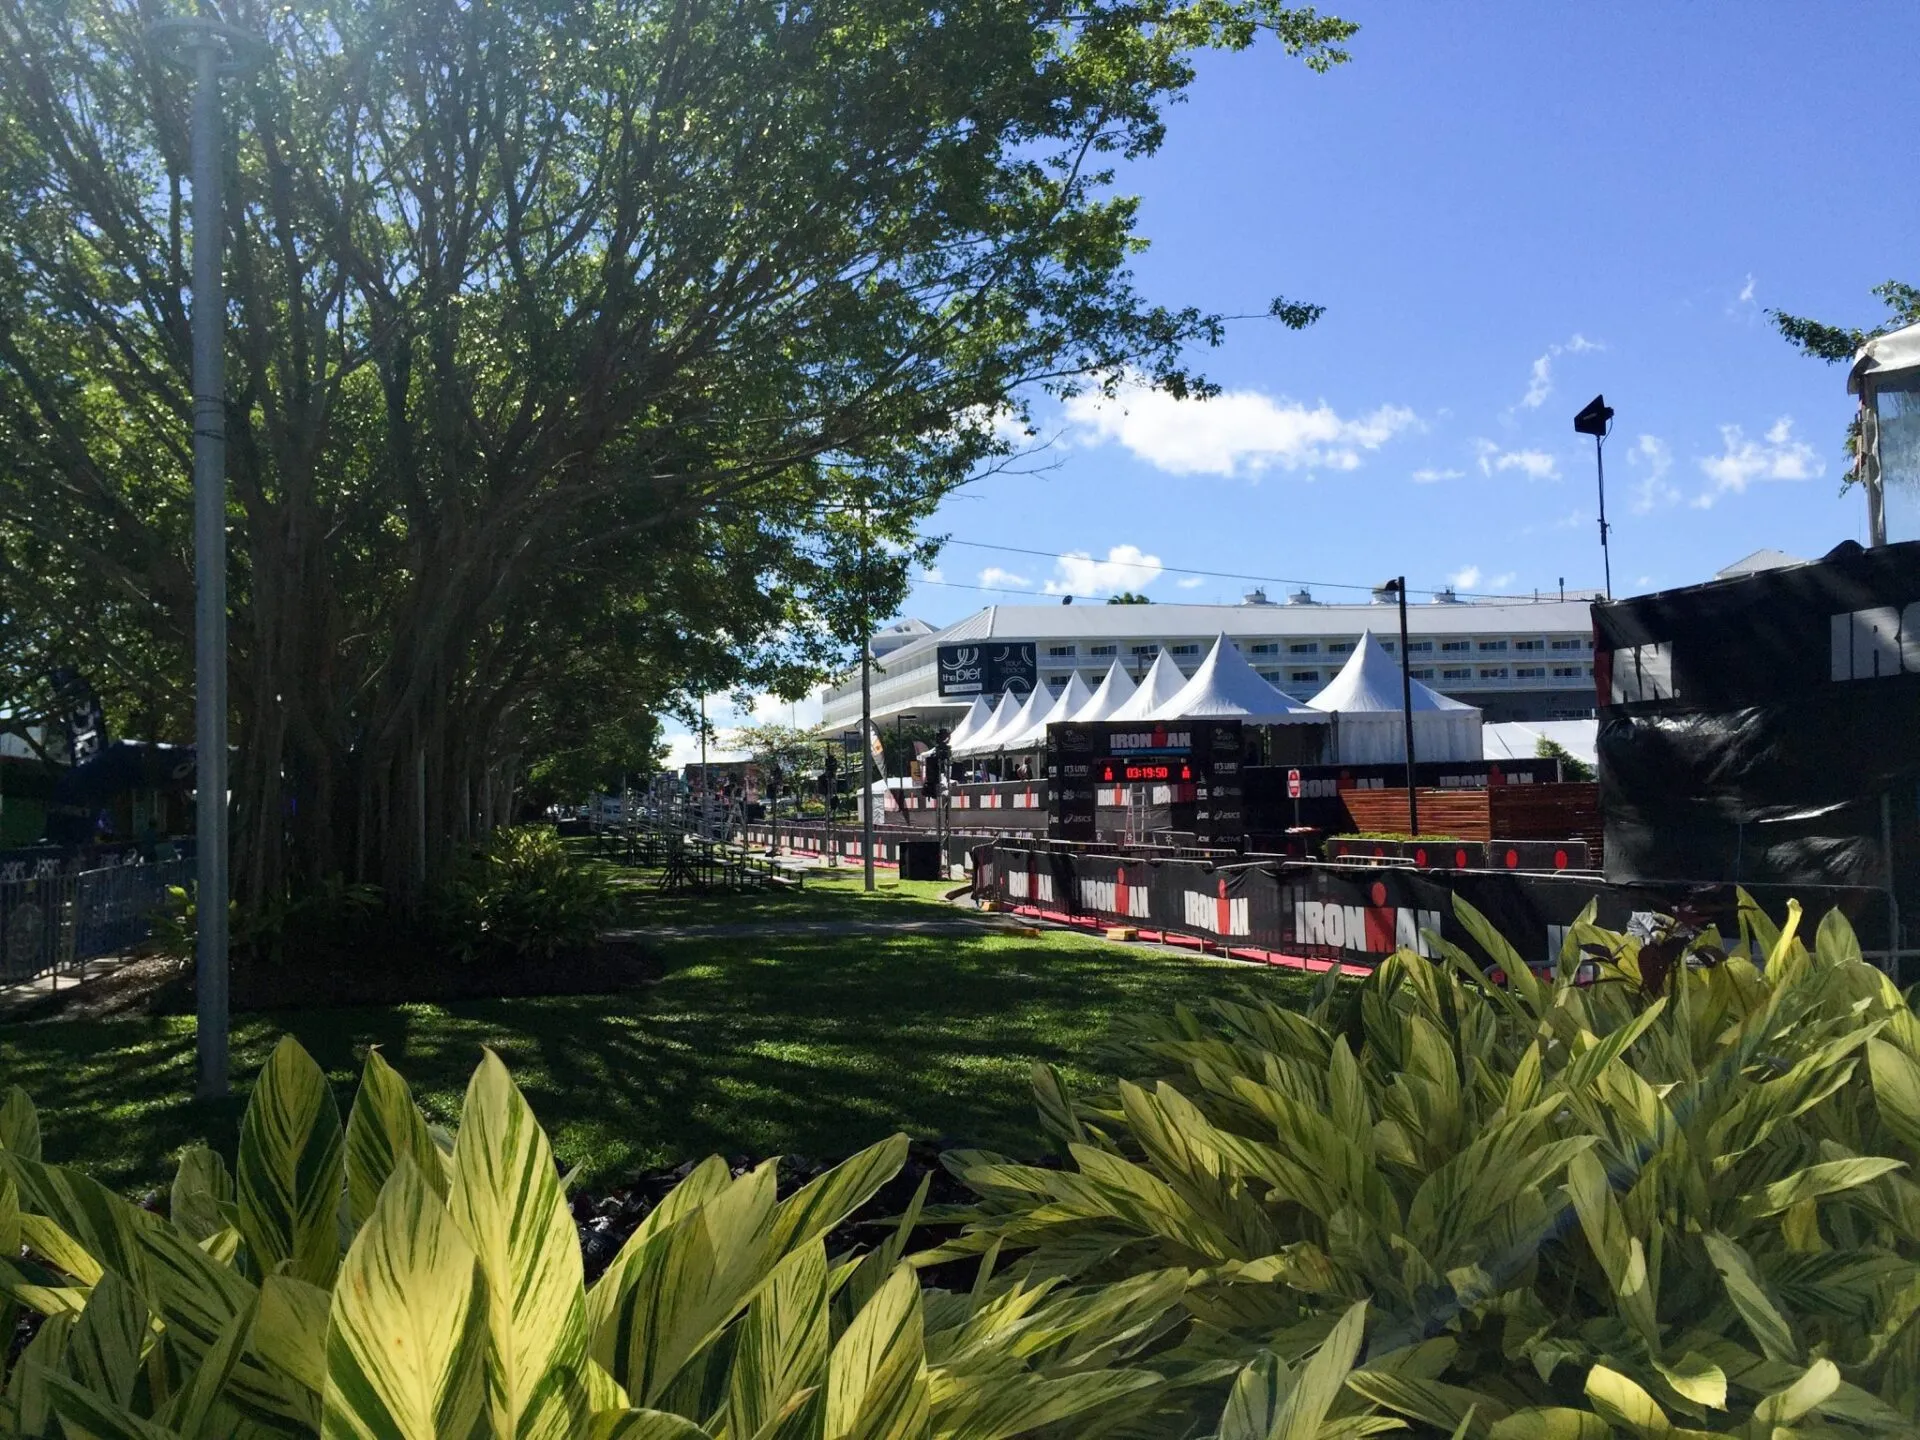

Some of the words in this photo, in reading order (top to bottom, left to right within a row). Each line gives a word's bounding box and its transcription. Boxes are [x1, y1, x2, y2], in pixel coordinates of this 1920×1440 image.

[942, 673, 955, 682] the
[955, 667, 982, 683] pier
[1110, 729, 1192, 748] IRONMAN
[1126, 767, 1168, 778] 03:19:50
[1081, 867, 1150, 918] IRONMAN
[1184, 879, 1250, 936] IRONMAN
[1295, 882, 1442, 959] IRONMAN
